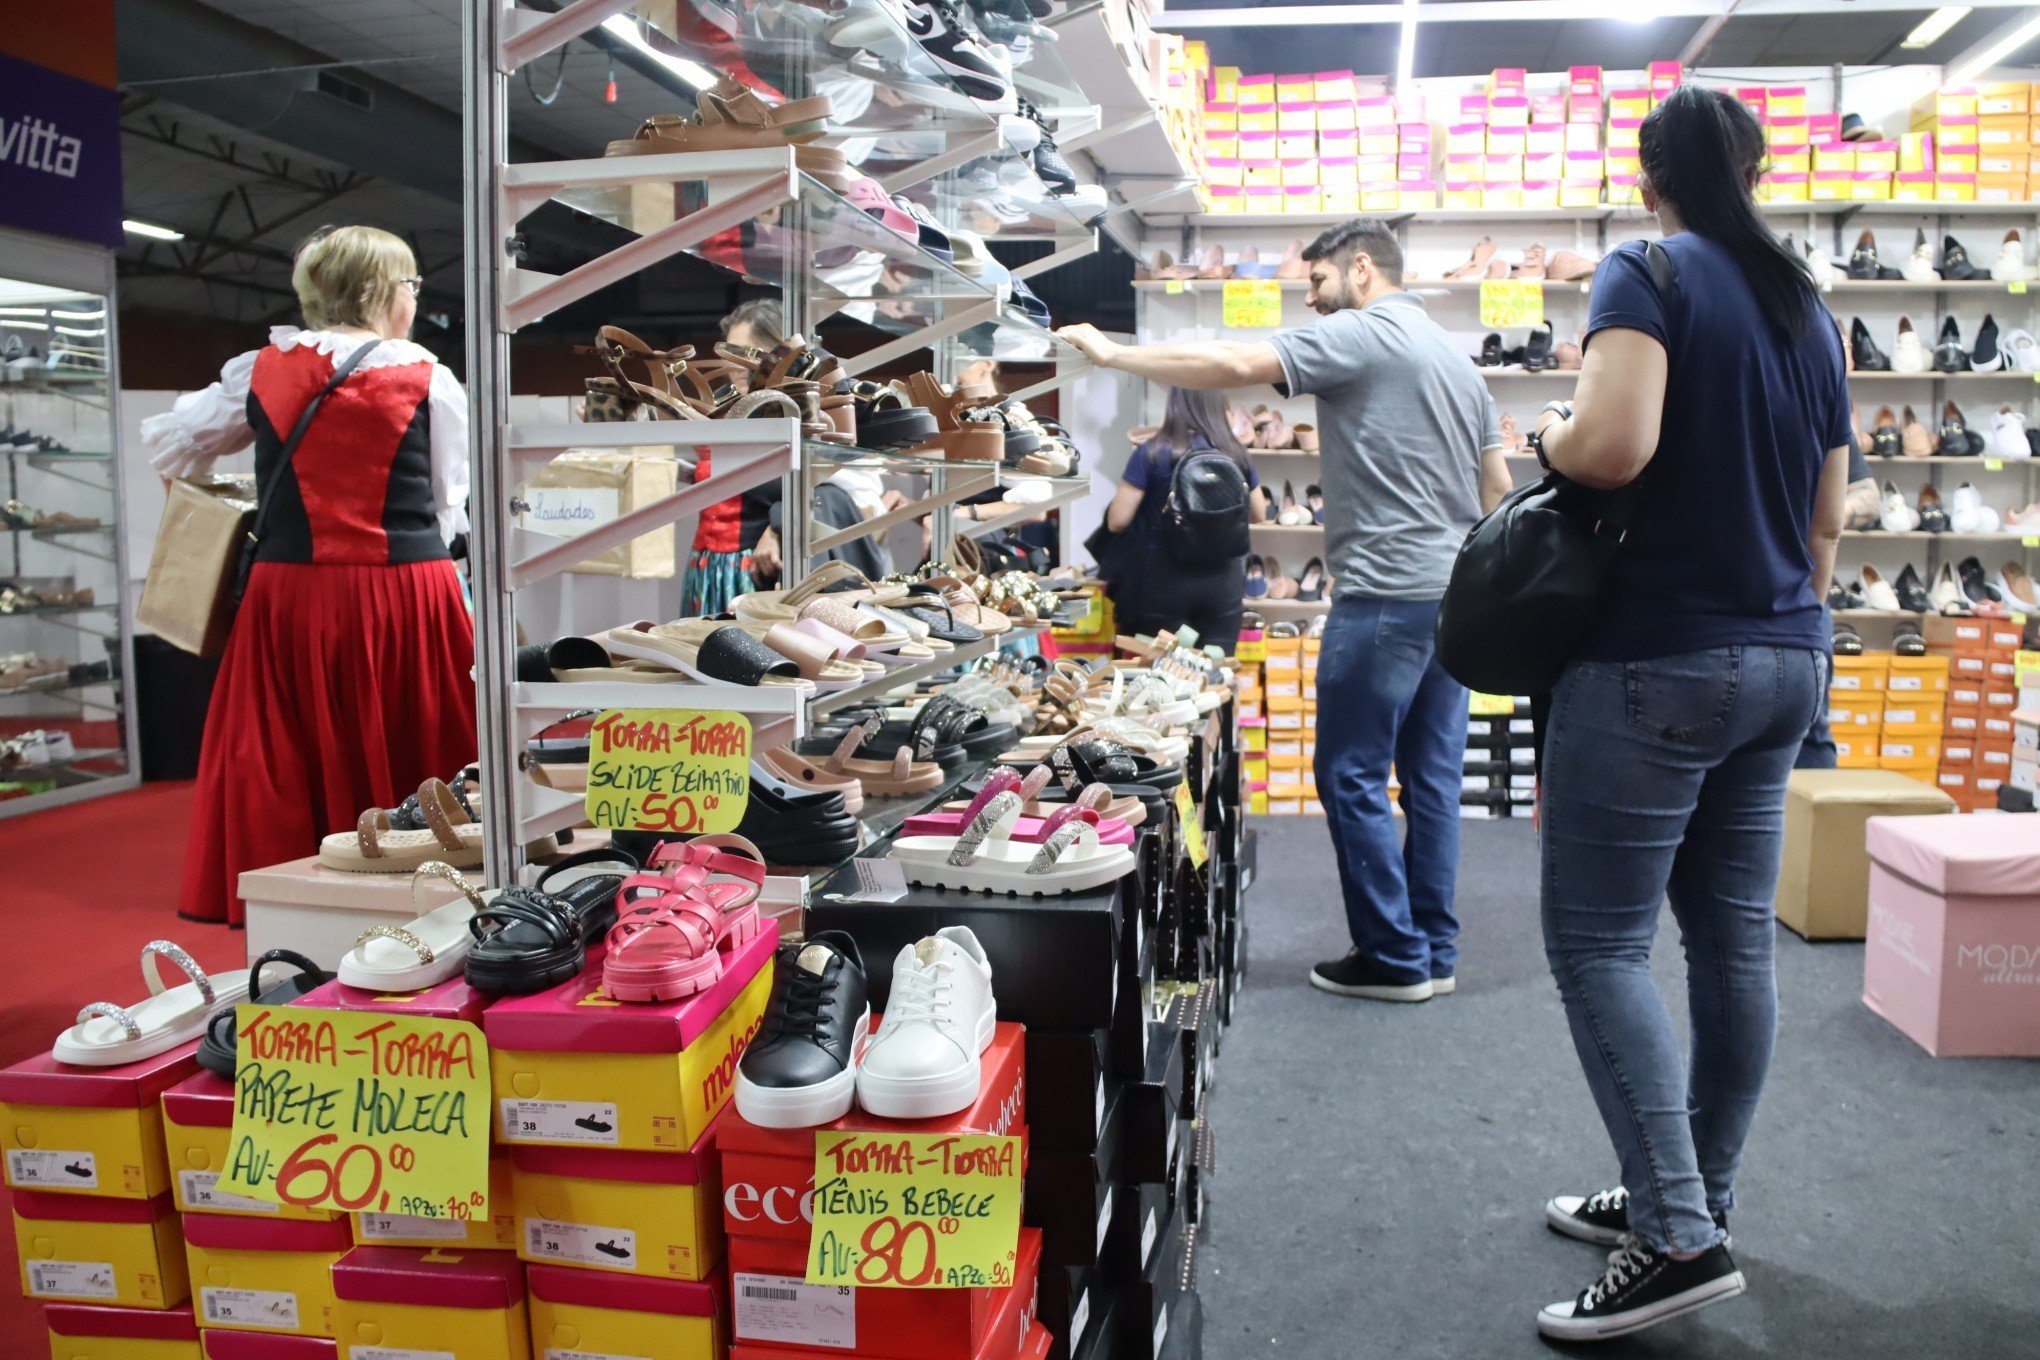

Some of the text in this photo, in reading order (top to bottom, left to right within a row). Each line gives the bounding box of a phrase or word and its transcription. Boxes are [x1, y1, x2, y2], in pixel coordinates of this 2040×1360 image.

[0, 115, 82, 178] vitta
[235, 1062, 469, 1138] PAPETE MOLECA
[522, 1121, 537, 1131] 38
[26, 1168, 38, 1177] 36
[199, 1191, 212, 1200] 36
[379, 1221, 391, 1230] 37
[545, 1241, 559, 1251] 38
[46, 1280, 57, 1288] 37
[837, 1285, 851, 1296] 35
